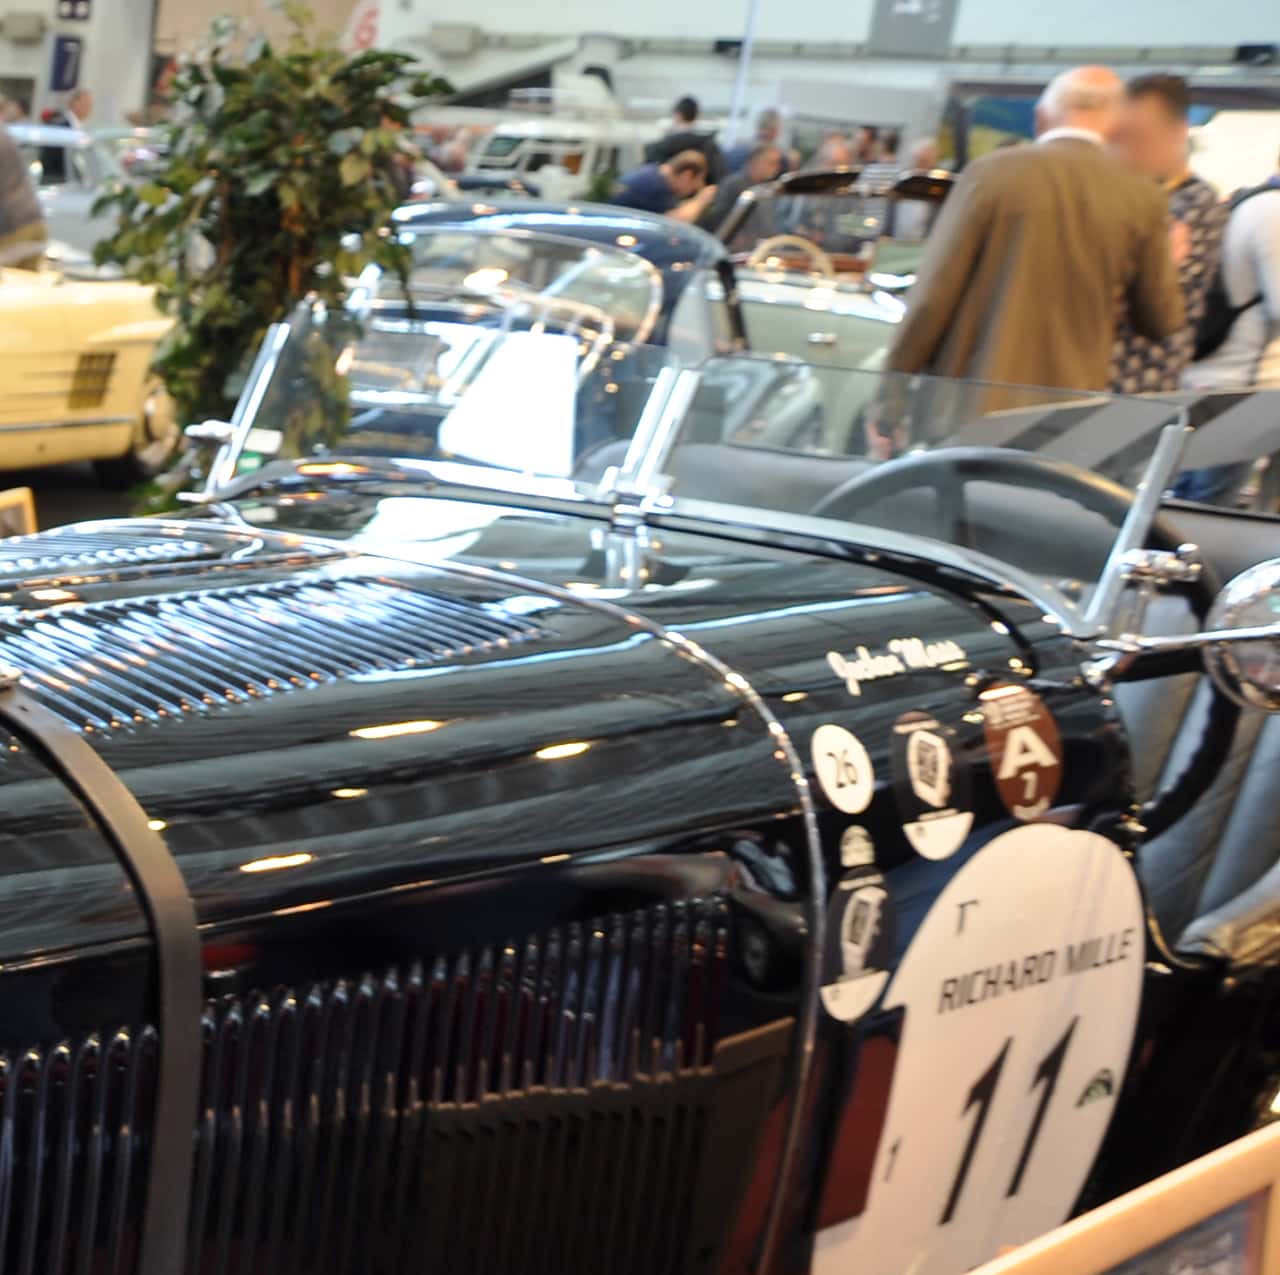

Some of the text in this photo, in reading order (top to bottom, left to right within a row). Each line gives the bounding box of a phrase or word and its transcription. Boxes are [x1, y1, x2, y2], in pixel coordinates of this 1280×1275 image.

[826, 748, 858, 789] 26
[998, 726, 1058, 779] A
[936, 928, 1135, 1014] RICHARD MILLE
[936, 1014, 1080, 1227] 11
